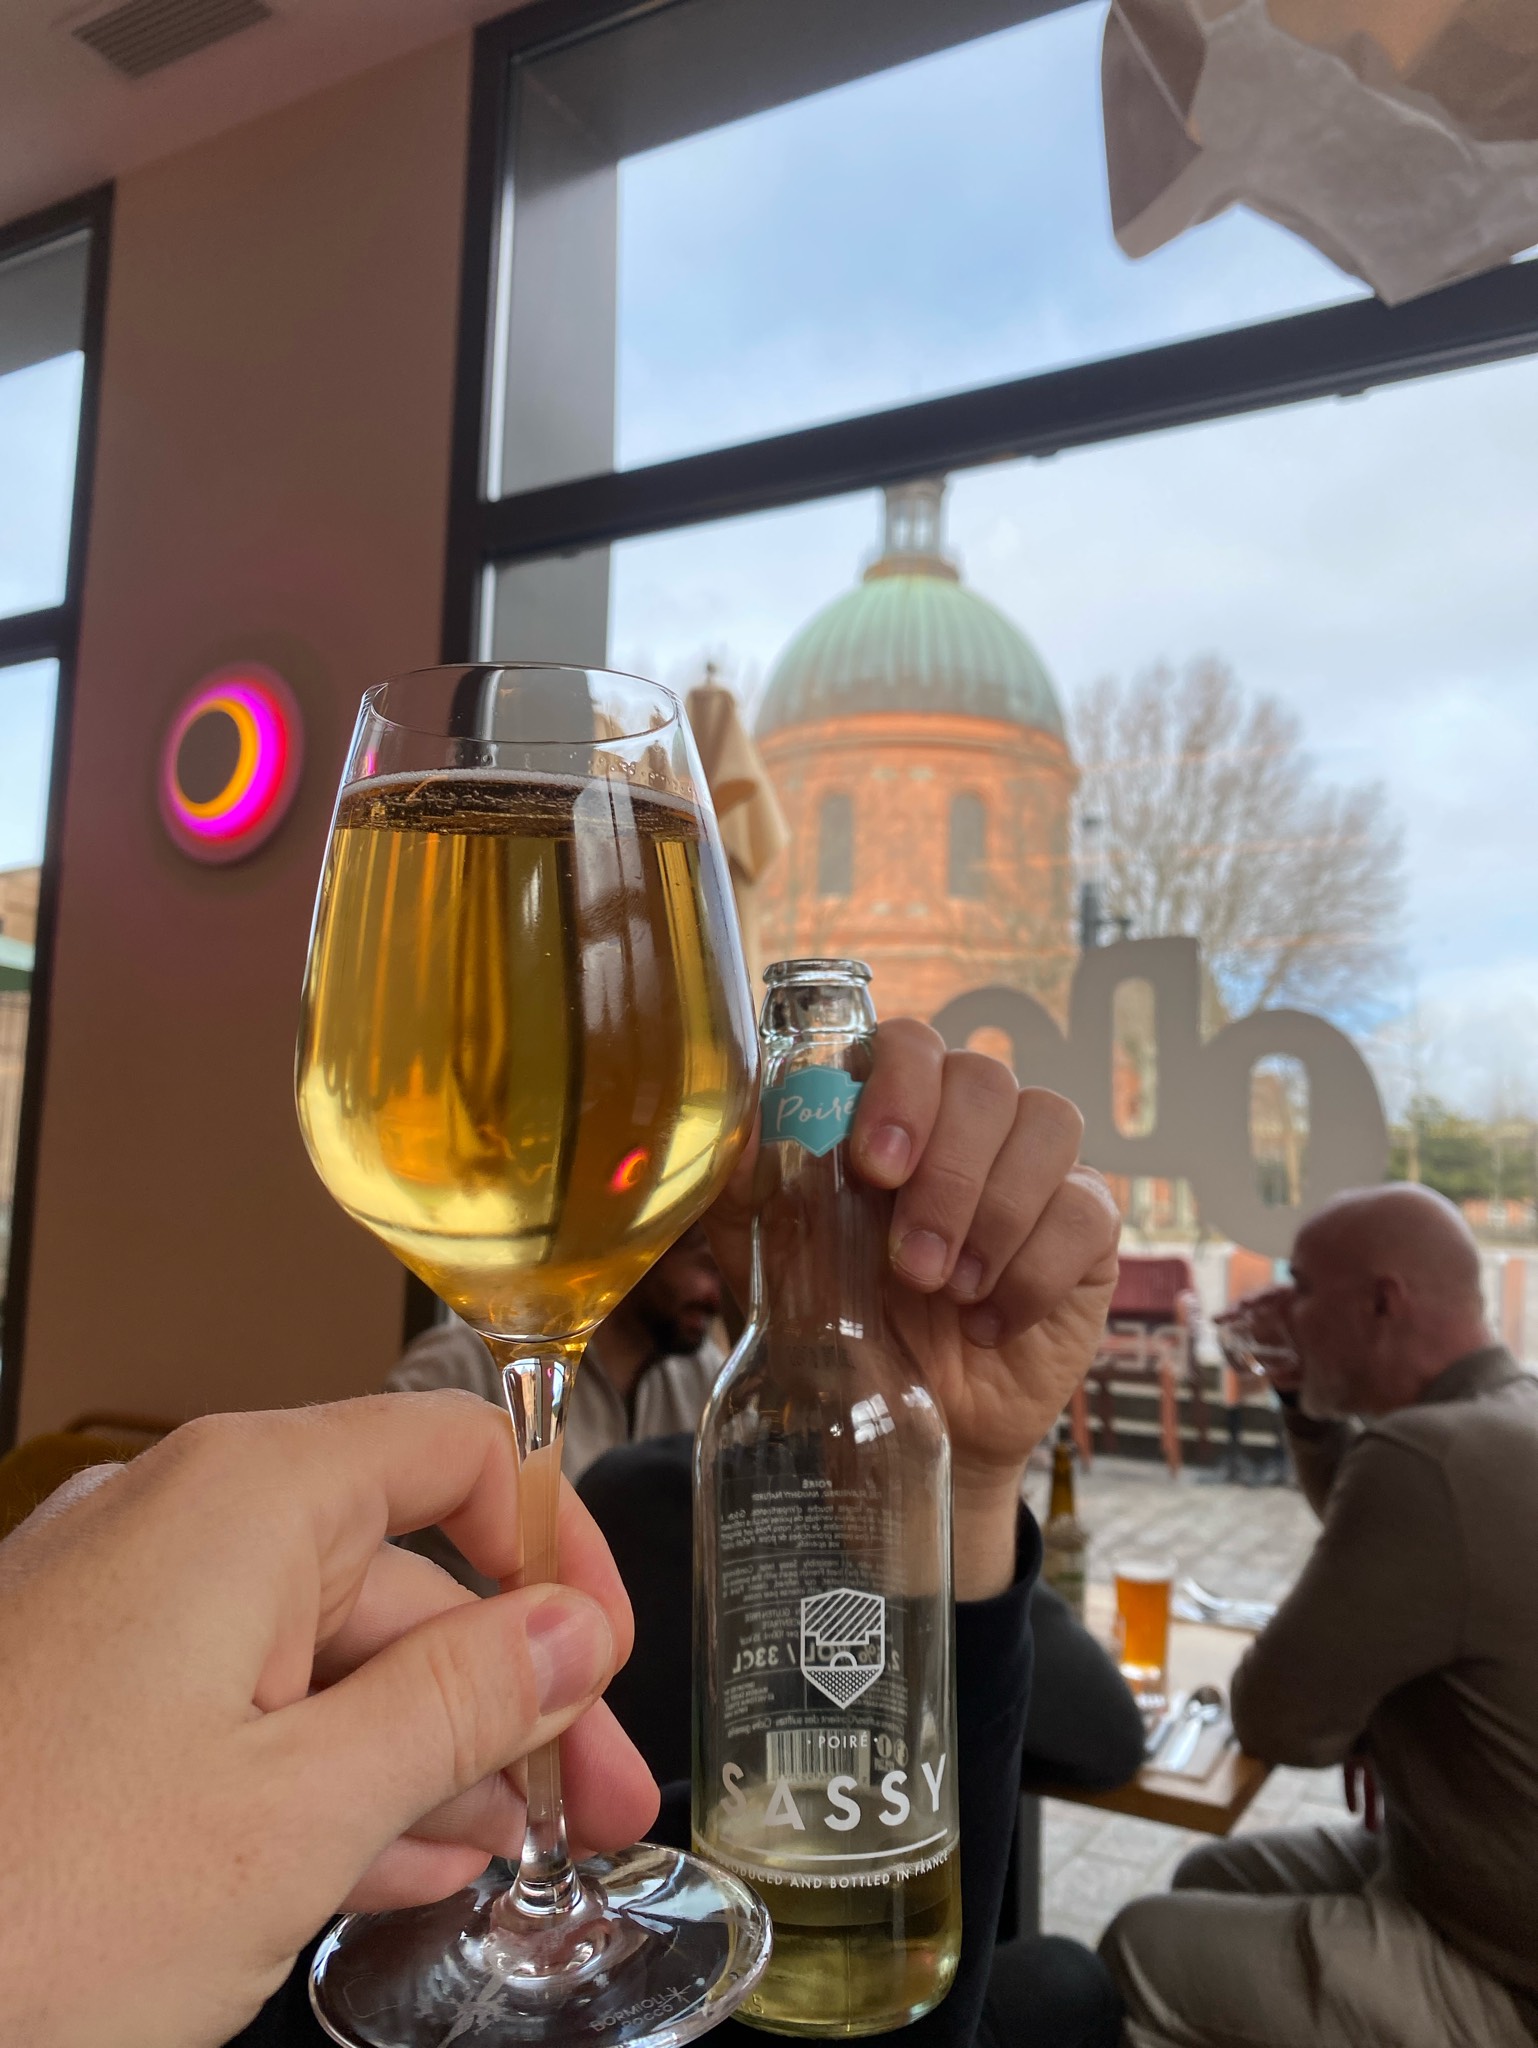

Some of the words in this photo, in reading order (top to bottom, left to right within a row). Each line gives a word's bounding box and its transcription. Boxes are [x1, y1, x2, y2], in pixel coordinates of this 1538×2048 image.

[818, 1731, 868, 1749] POIRÉ
[720, 1752, 947, 1832] SASSY
[717, 1859, 783, 1886] ODUCED
[790, 1875, 822, 1889] AND
[830, 1874, 890, 1889] BOTTLED
[896, 1865, 910, 1881] IN
[915, 1850, 949, 1877] FRANCE
